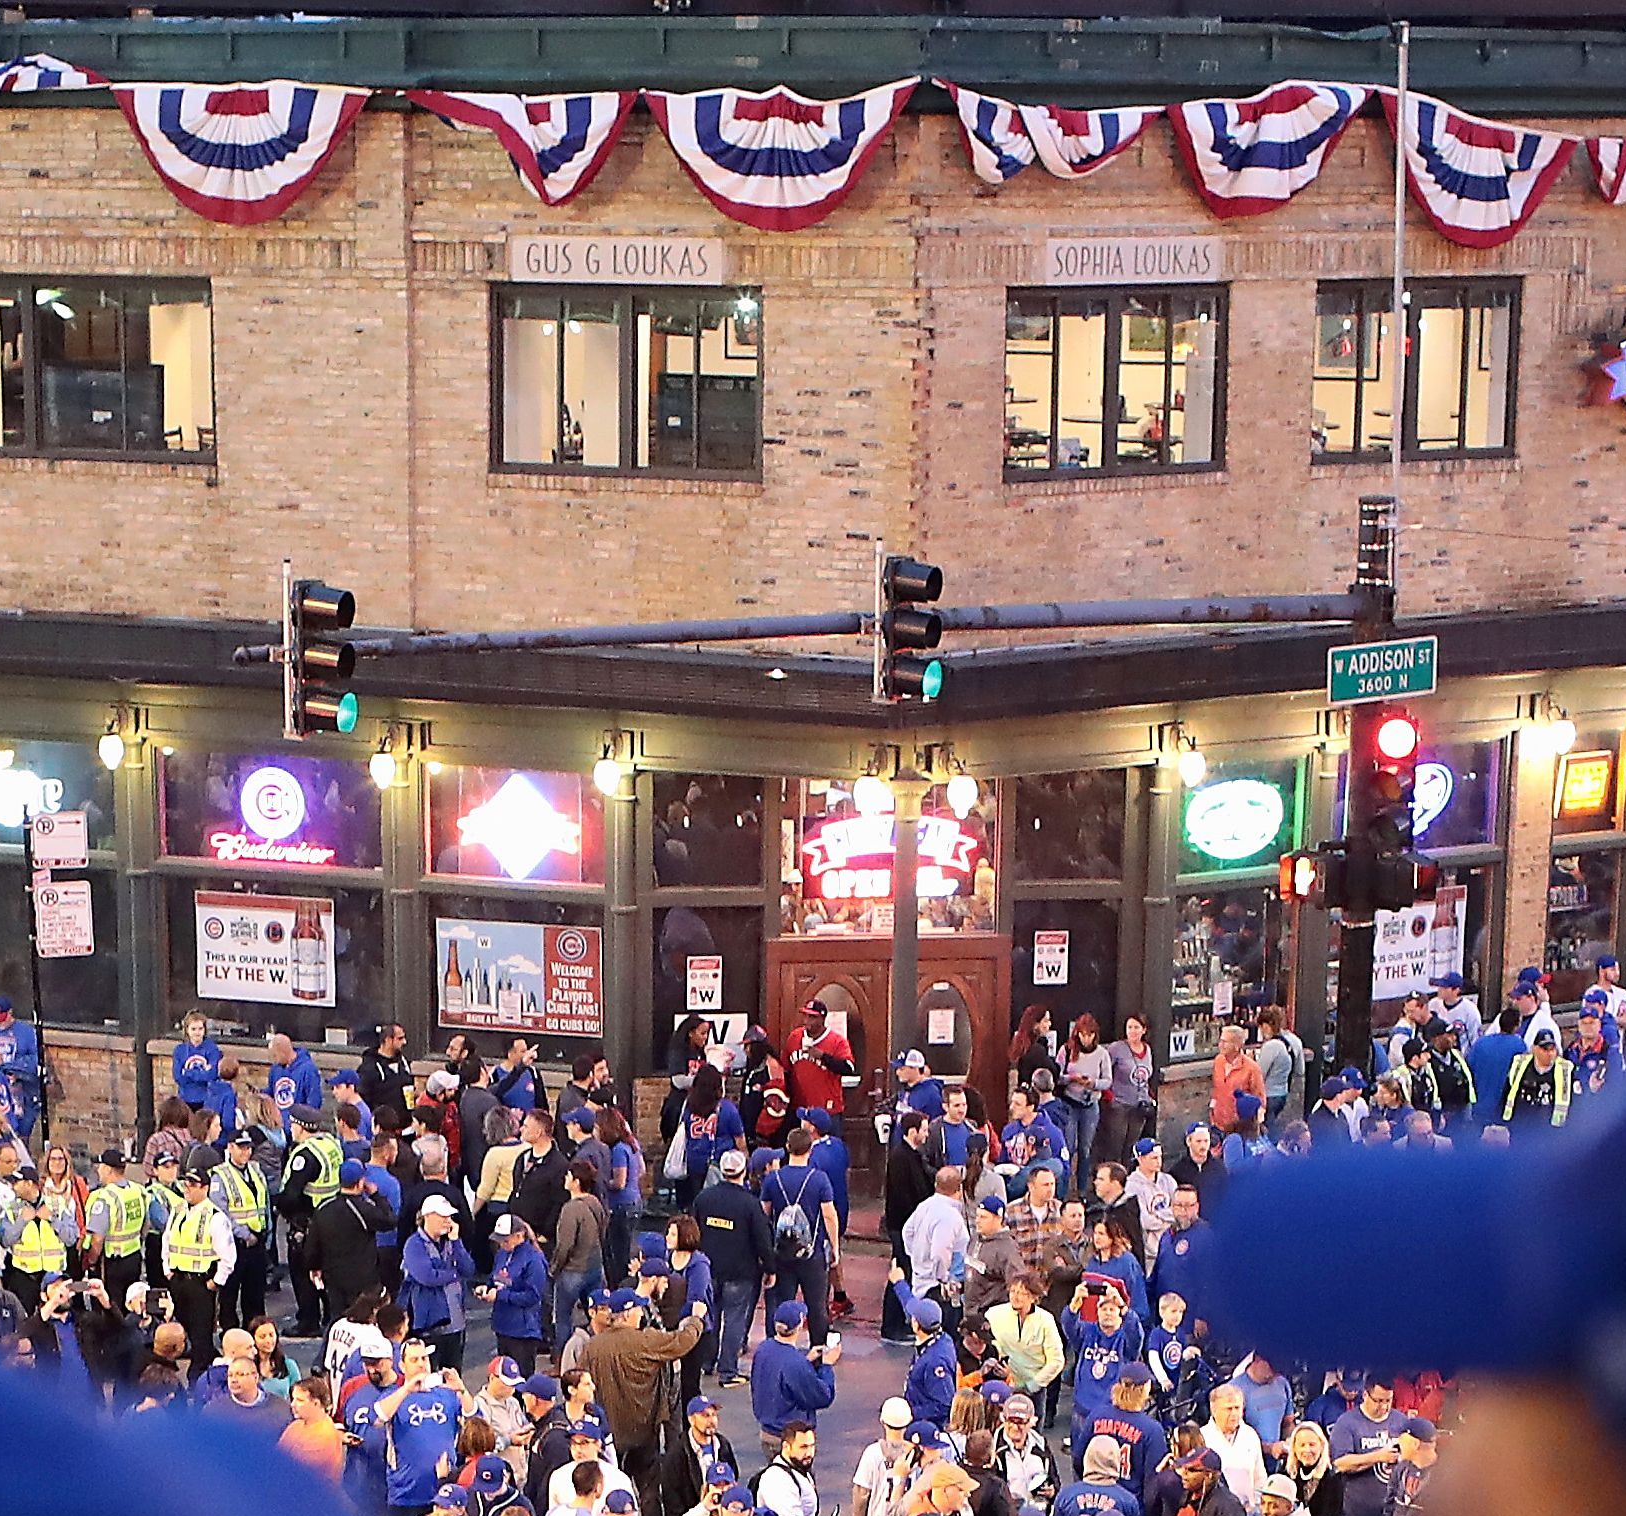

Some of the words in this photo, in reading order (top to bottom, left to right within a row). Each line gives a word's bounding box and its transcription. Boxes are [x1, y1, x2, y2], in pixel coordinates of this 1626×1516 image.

[526, 242, 572, 275] GUS
[585, 243, 601, 276] G
[612, 243, 708, 277] LOUKAS
[1053, 244, 1125, 278] SOPHIA
[1133, 243, 1211, 276] LOUKAS
[1334, 659, 1344, 674] W
[1348, 647, 1414, 677] ADDISON
[1418, 648, 1432, 664] ST
[1358, 676, 1392, 693] 3600
[1399, 673, 1408, 689] N
[210, 832, 335, 864] Budweiser
[480, 938, 490, 947] W
[239, 954, 258, 965] OUR
[205, 965, 231, 980] FLY
[236, 967, 265, 982] THE
[550, 962, 594, 978] WELCOME
[1046, 964, 1062, 978] W
[1385, 964, 1408, 980] THE
[558, 977, 570, 989] TO
[571, 979, 587, 990] THE
[552, 989, 594, 1003] PLAYOFFS
[699, 990, 715, 1004] W
[546, 1000, 571, 1015] CUBS
[572, 1002, 599, 1016] FANS!
[546, 1019, 559, 1030] GO
[560, 1020, 583, 1031] CUBS
[584, 1020, 600, 1032] GO!
[1173, 1035, 1188, 1052] W
[690, 1112, 719, 1141] 24
[333, 1329, 356, 1347] IZZO
[1093, 1418, 1143, 1444] CHAPMAN
[1076, 1493, 1116, 1511] PRIOR
